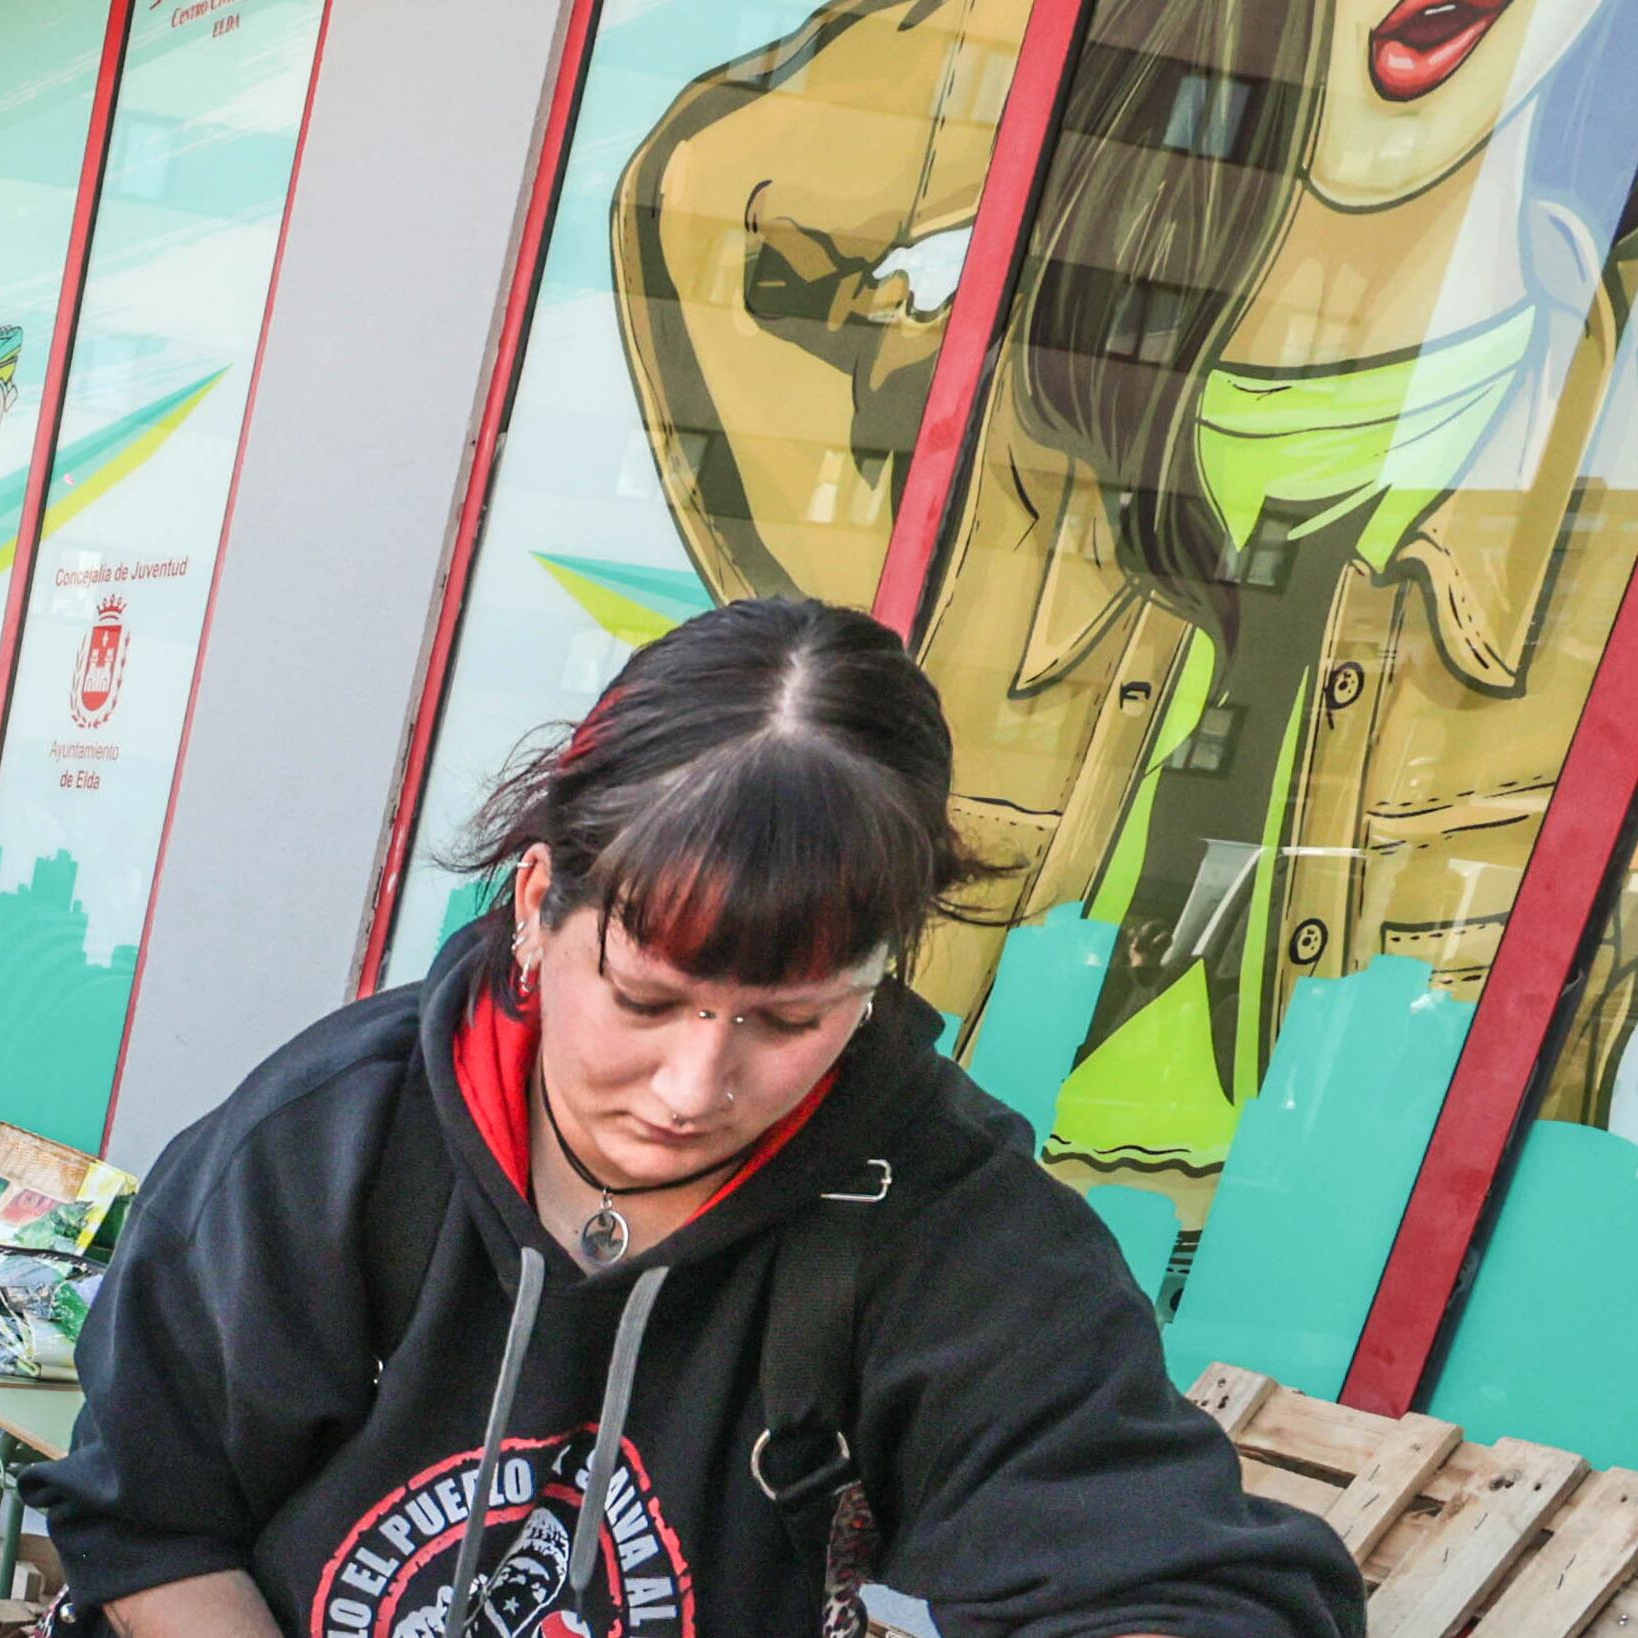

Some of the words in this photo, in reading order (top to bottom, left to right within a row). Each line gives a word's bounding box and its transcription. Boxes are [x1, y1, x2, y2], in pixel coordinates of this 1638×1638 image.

[114, 563, 129, 582] de
[131, 556, 189, 581] Juventud
[50, 739, 120, 764] Ayuntamiento
[59, 770, 74, 788] de
[75, 770, 102, 790] Elda
[341, 1543, 400, 1598] EL
[624, 1576, 677, 1627] AL
